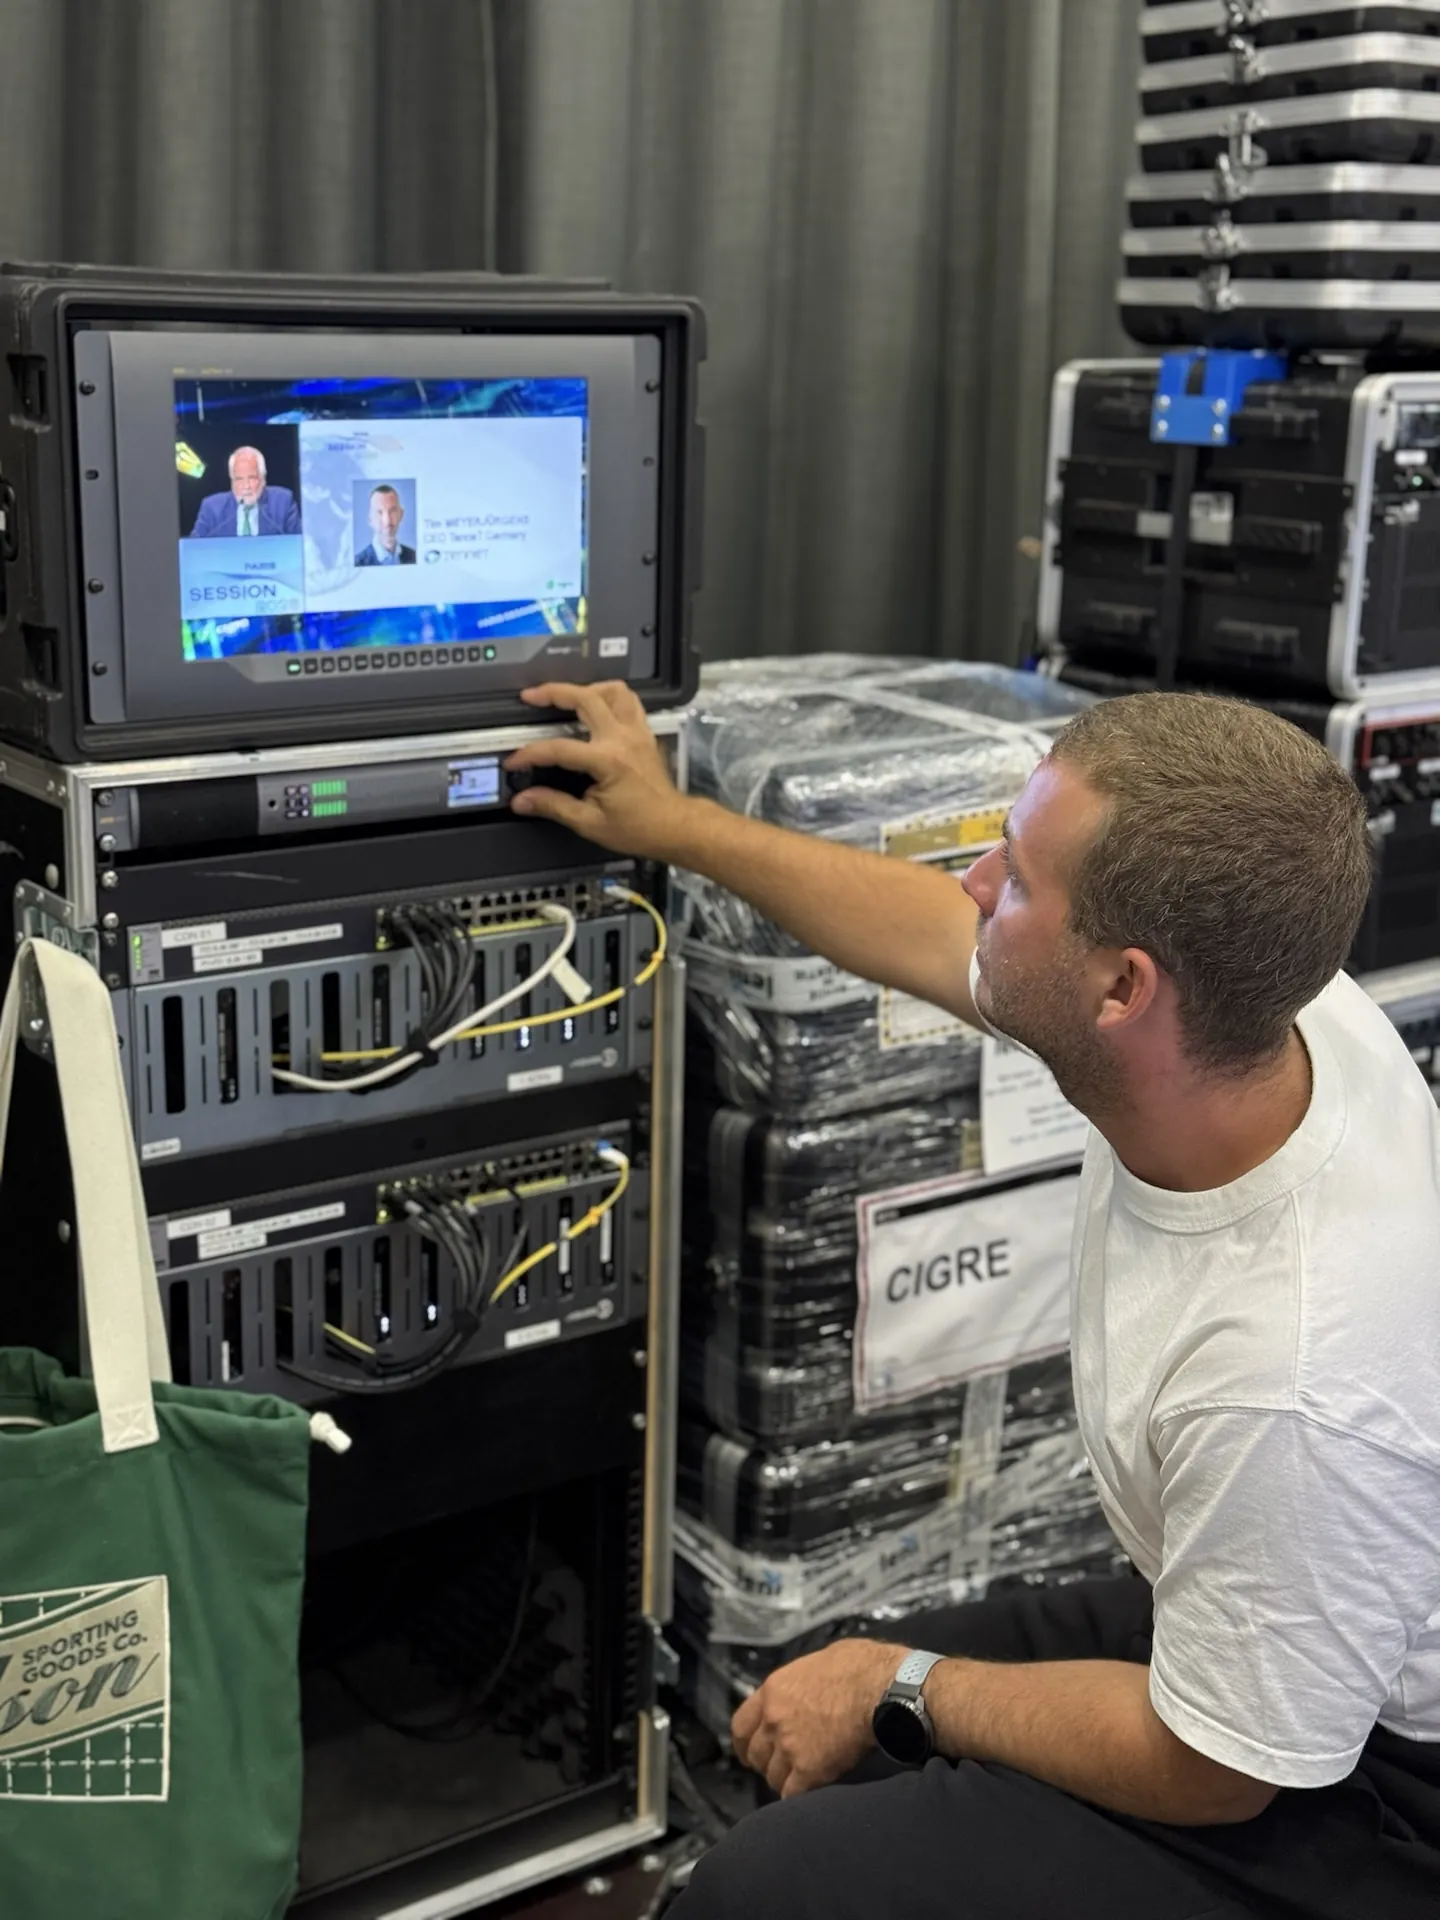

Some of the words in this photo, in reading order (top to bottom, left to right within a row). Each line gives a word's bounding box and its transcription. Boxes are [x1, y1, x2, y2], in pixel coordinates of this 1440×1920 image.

[189, 584, 277, 602] SESSION
[886, 1238, 1010, 1303] CIGRE
[22, 1609, 138, 1667] SPORTING
[22, 1641, 107, 1684] GOODS
[0, 1652, 161, 1736] son
